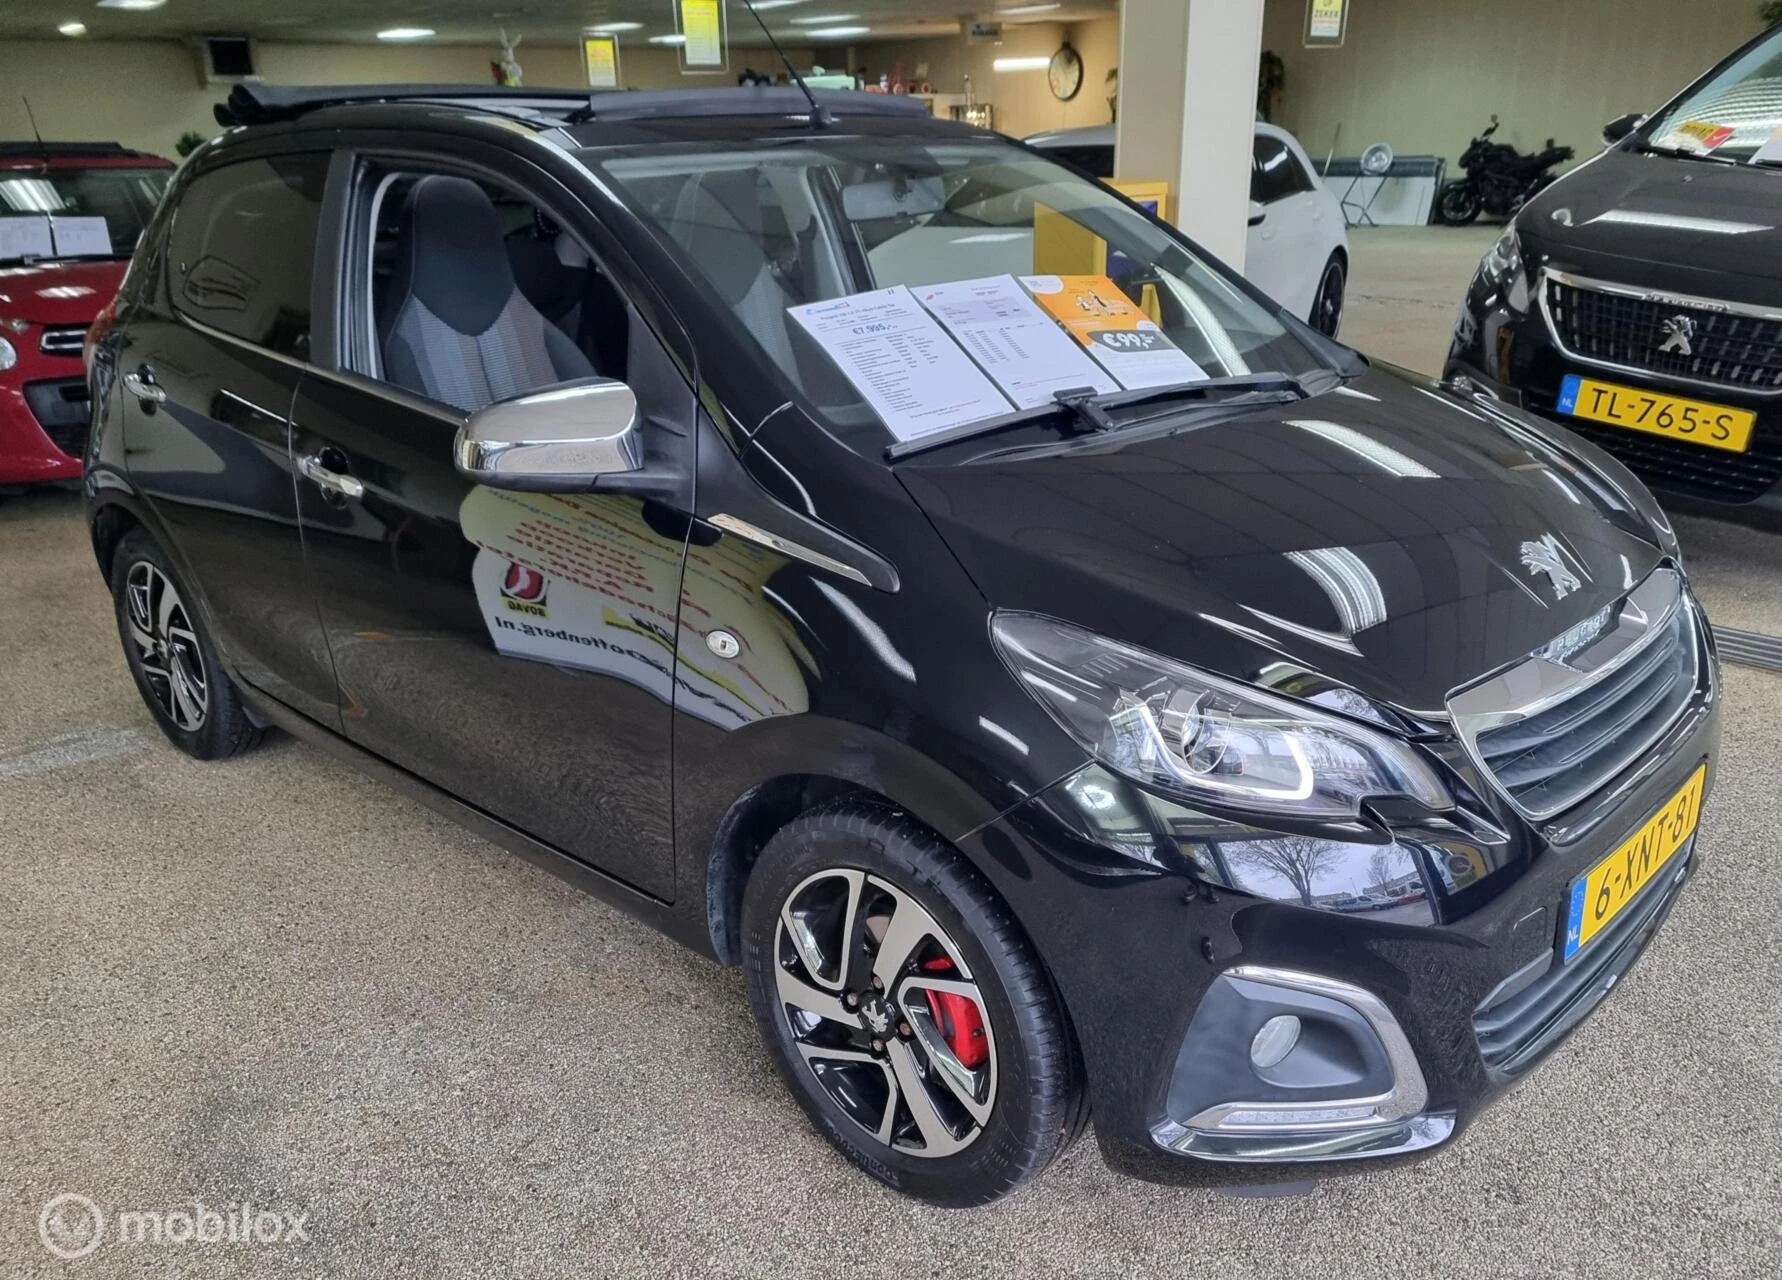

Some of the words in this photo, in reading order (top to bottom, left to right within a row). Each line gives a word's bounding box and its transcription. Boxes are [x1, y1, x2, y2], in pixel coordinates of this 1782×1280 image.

[1561, 397, 1574, 410] NL
[1591, 388, 1735, 441] TL-765-S
[1594, 788, 1697, 921] 6-XNT-81
[1566, 925, 1579, 944] NL
